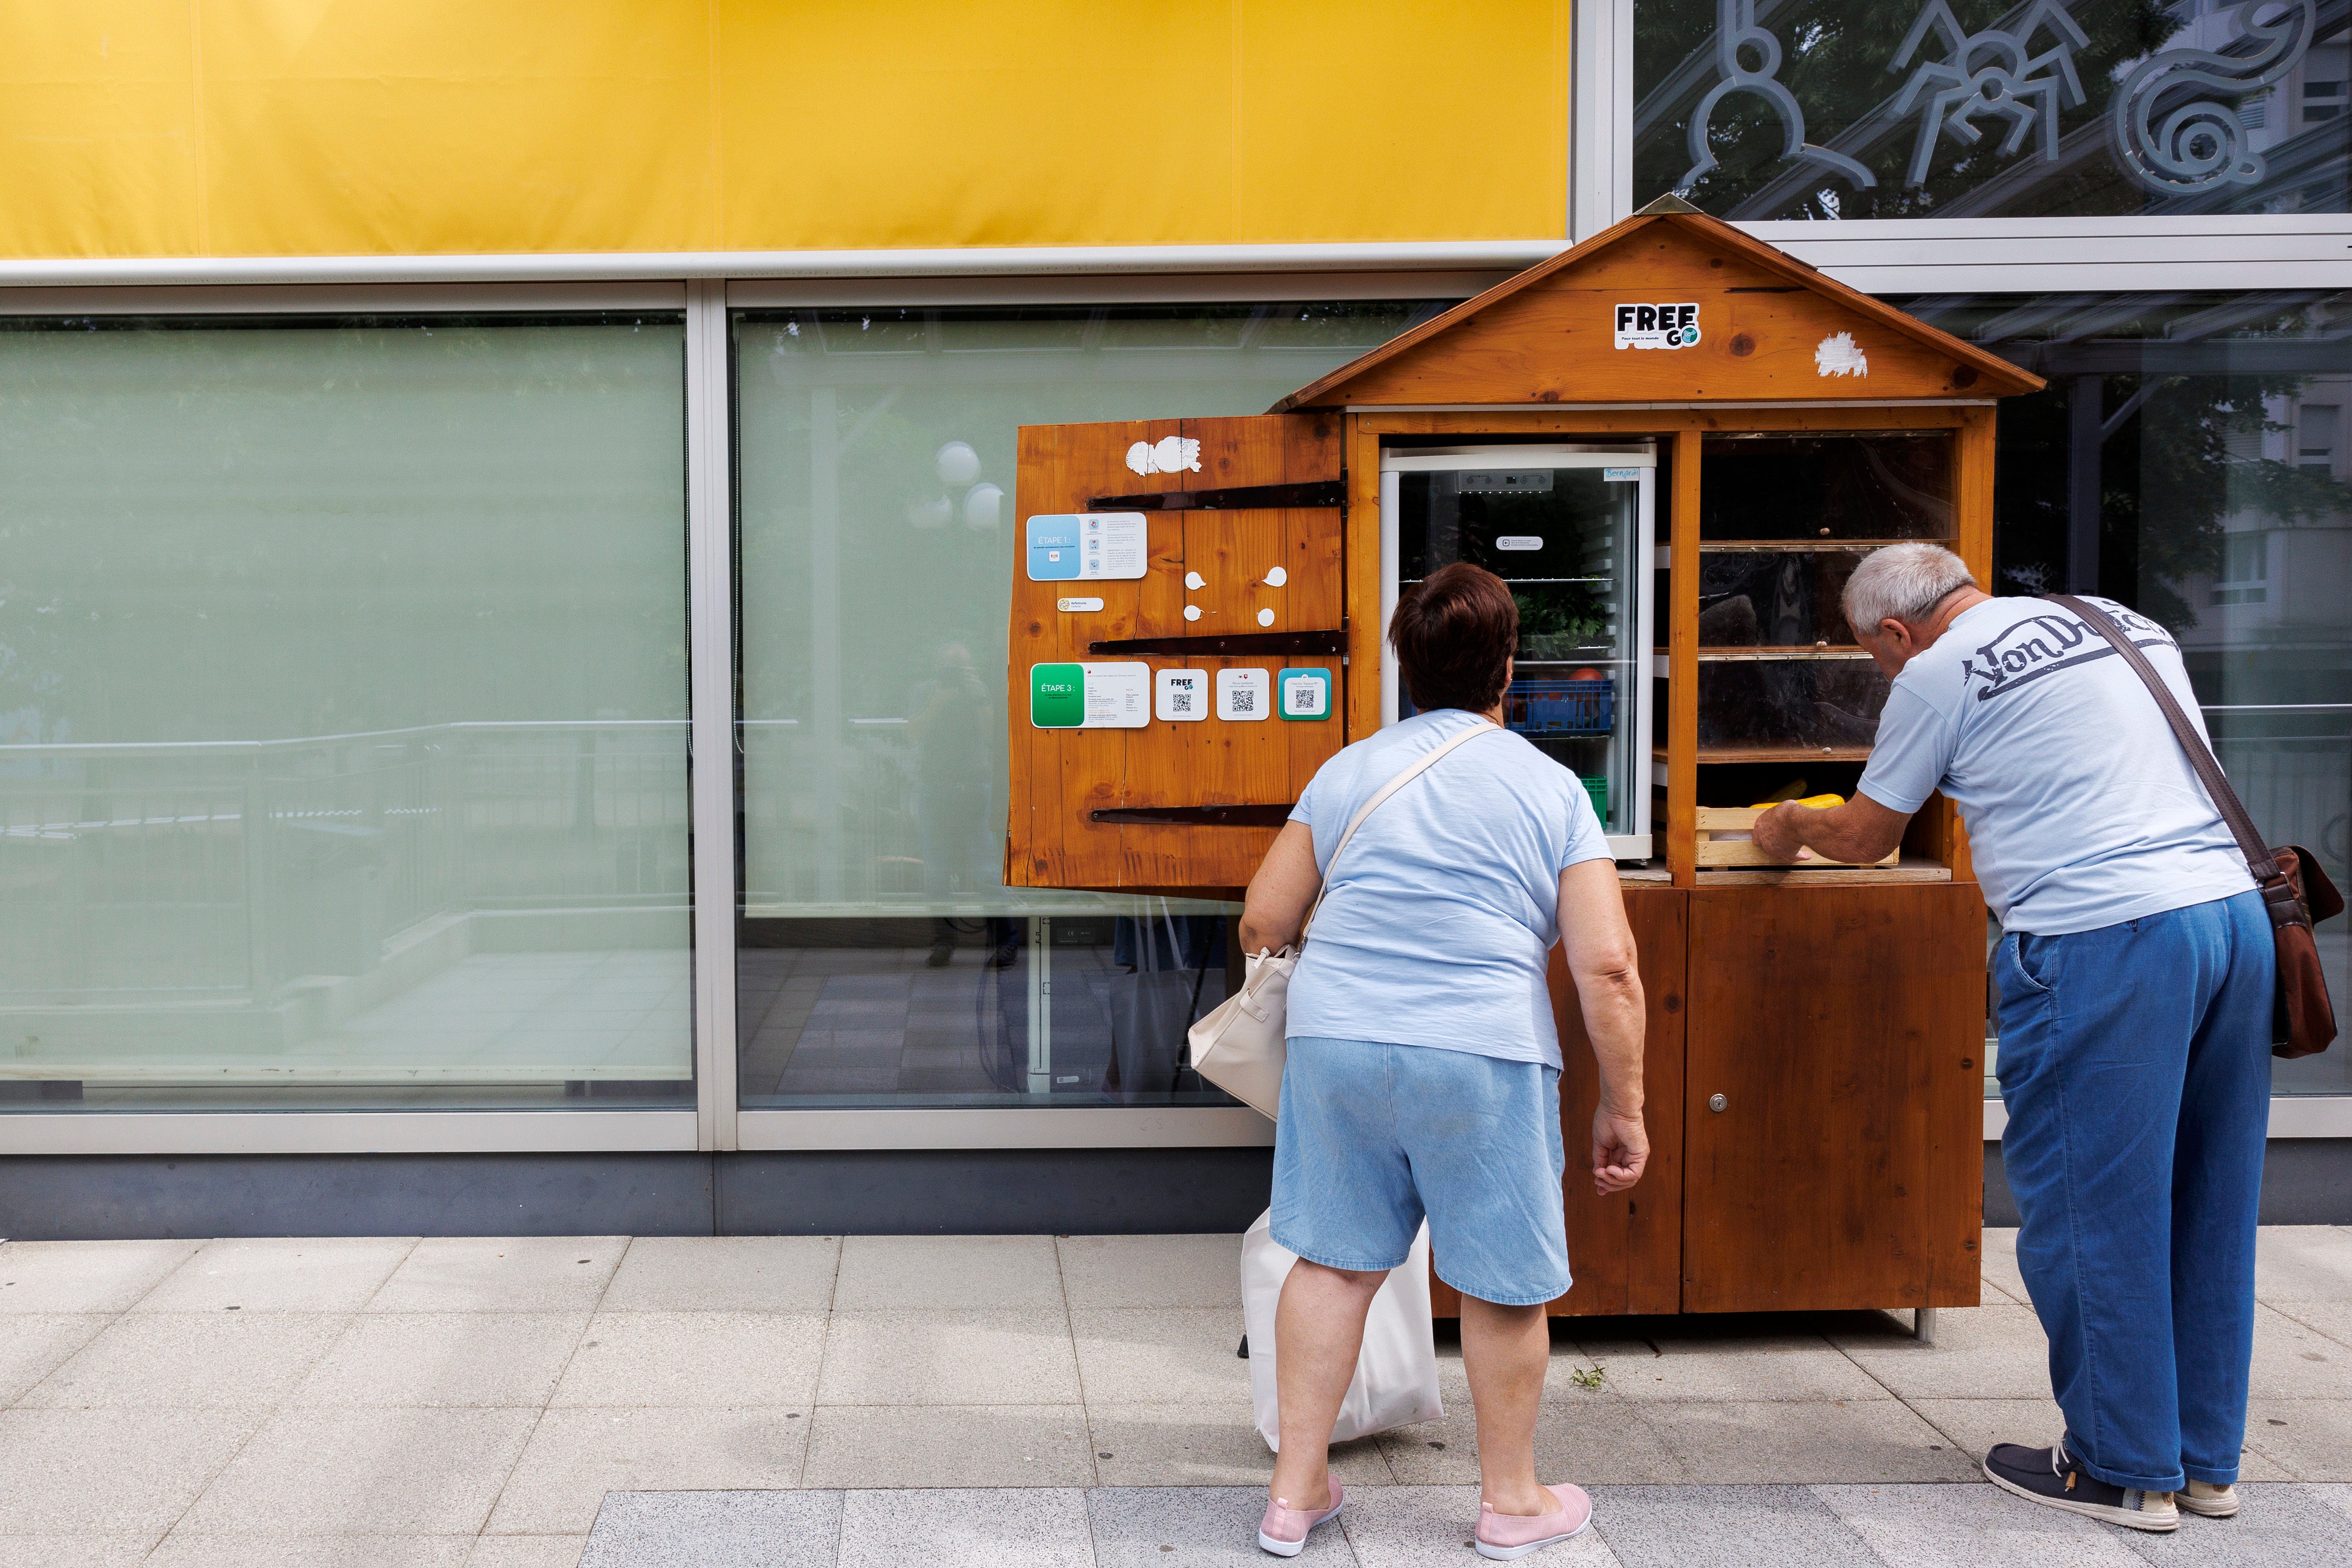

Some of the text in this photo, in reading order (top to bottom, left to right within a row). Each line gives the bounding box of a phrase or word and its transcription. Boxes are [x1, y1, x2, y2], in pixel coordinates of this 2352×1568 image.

[1617, 305, 1696, 332] FREE
[1038, 536, 1062, 544] ÉTAPE
[1041, 683, 1065, 692] ÉTAPE
